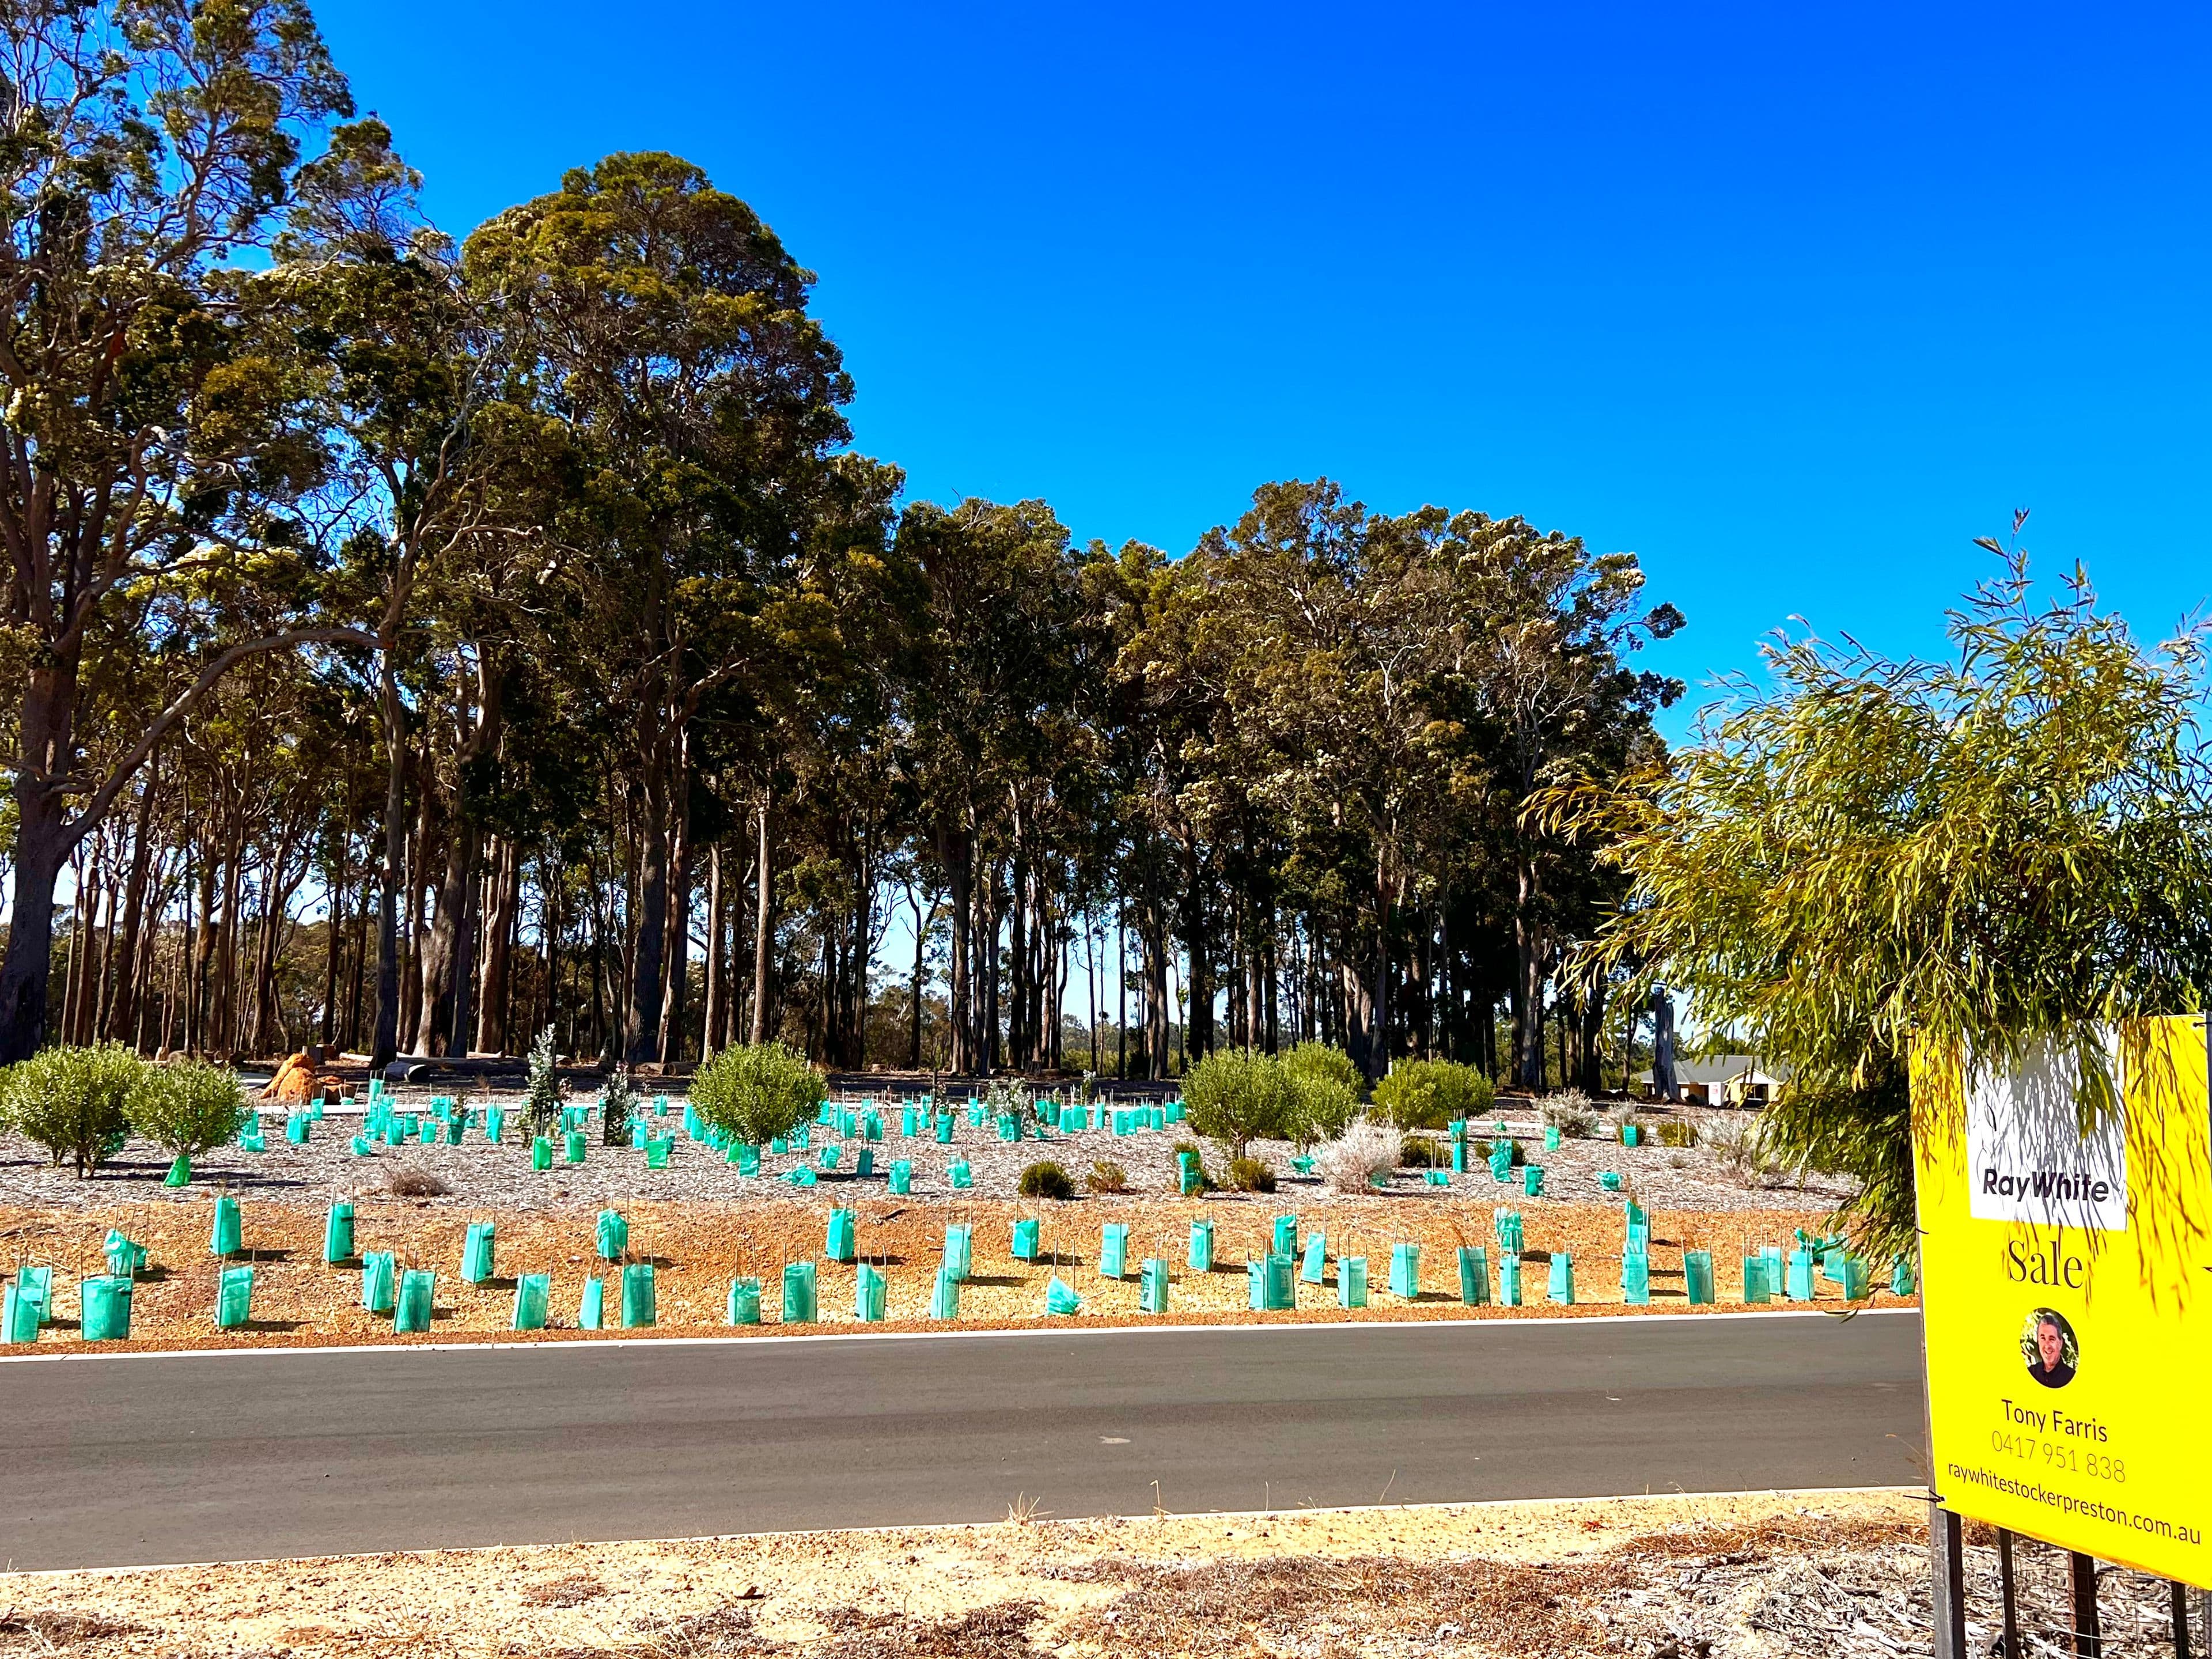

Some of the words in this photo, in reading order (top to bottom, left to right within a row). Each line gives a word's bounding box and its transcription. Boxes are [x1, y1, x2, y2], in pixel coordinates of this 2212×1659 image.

[2009, 1240, 2083, 1289] Sale
[2001, 1399, 2046, 1433] Tony
[2052, 1410, 2107, 1442] Farris
[1992, 1430, 2035, 1460] 0417
[2043, 1443, 2078, 1472] 951
[2086, 1453, 2125, 1483] 838
[1948, 1463, 2200, 1545] raywhitestockerpreston.com.au
